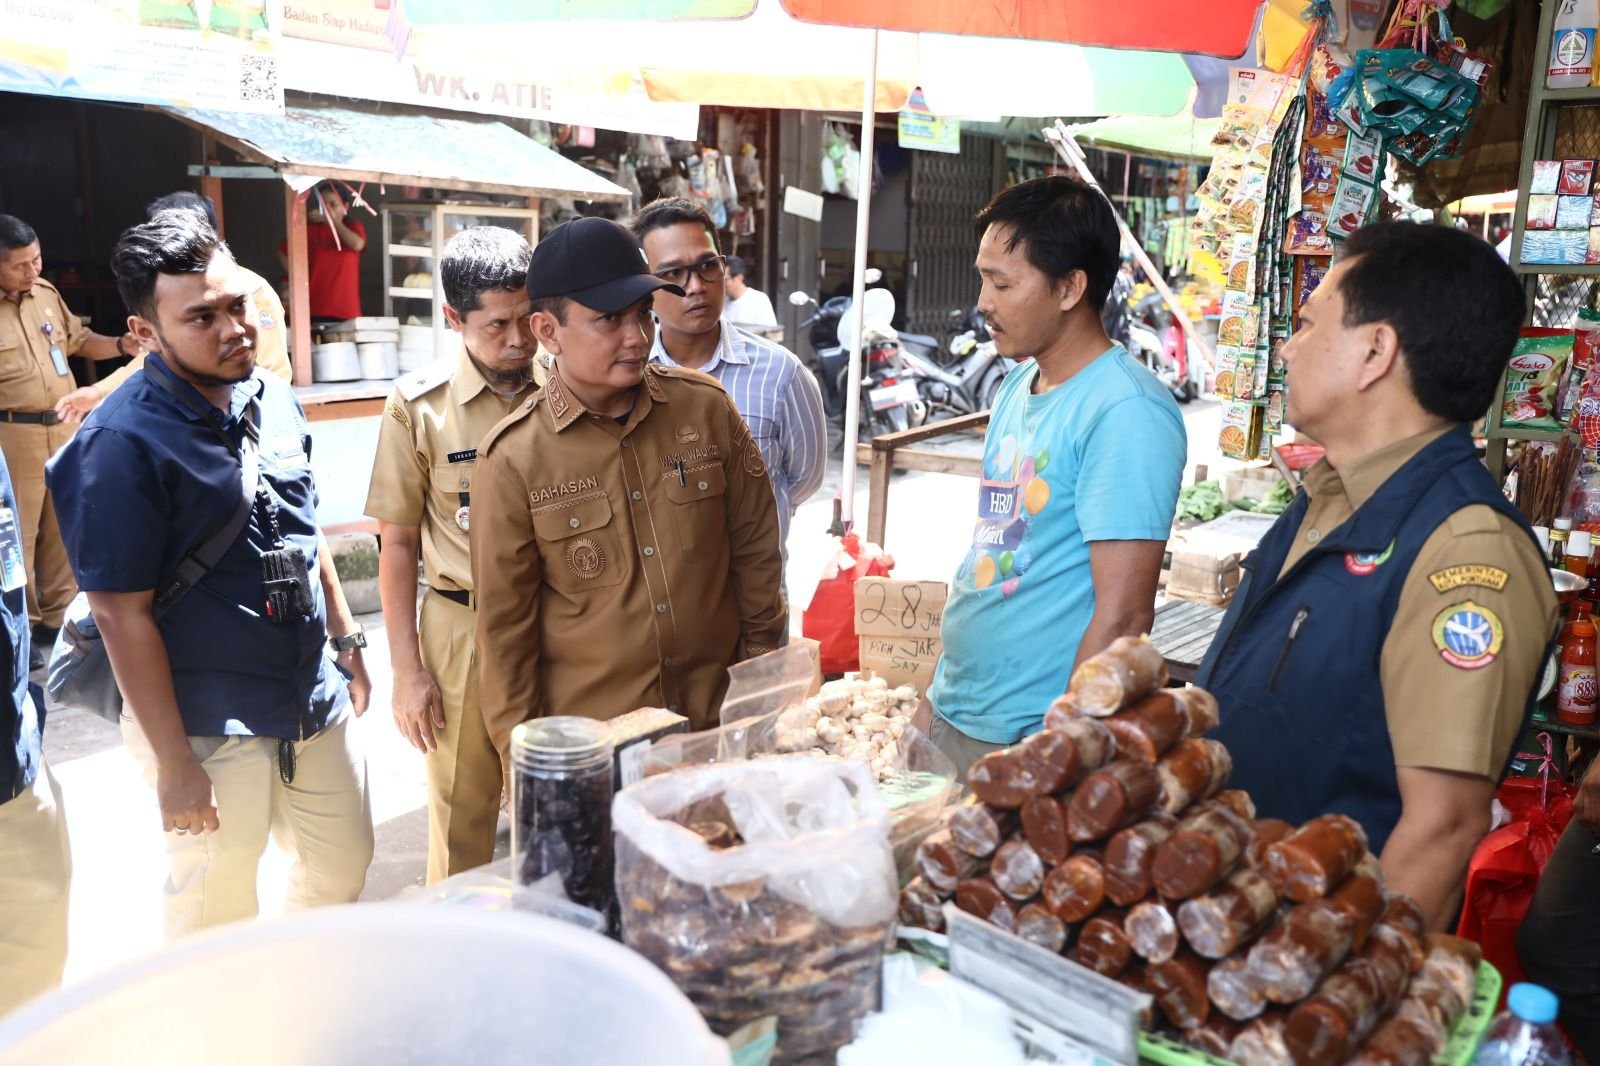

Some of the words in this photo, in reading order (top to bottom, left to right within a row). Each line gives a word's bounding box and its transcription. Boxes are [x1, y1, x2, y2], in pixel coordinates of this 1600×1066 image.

[5, 0, 24, 17] Rp
[283, 6, 318, 24] Badan
[322, 13, 345, 31] Siap
[412, 64, 480, 101] WK.
[491, 82, 552, 111] ATIE
[1512, 357, 1546, 369] Sasa
[530, 475, 598, 503] BAHASAN
[990, 491, 1013, 514] HBD
[1435, 566, 1504, 581] PEMERINTAH
[860, 582, 922, 630] 28
[900, 637, 936, 657] JAK
[889, 656, 920, 674] SAY
[1576, 680, 1596, 697] 888
